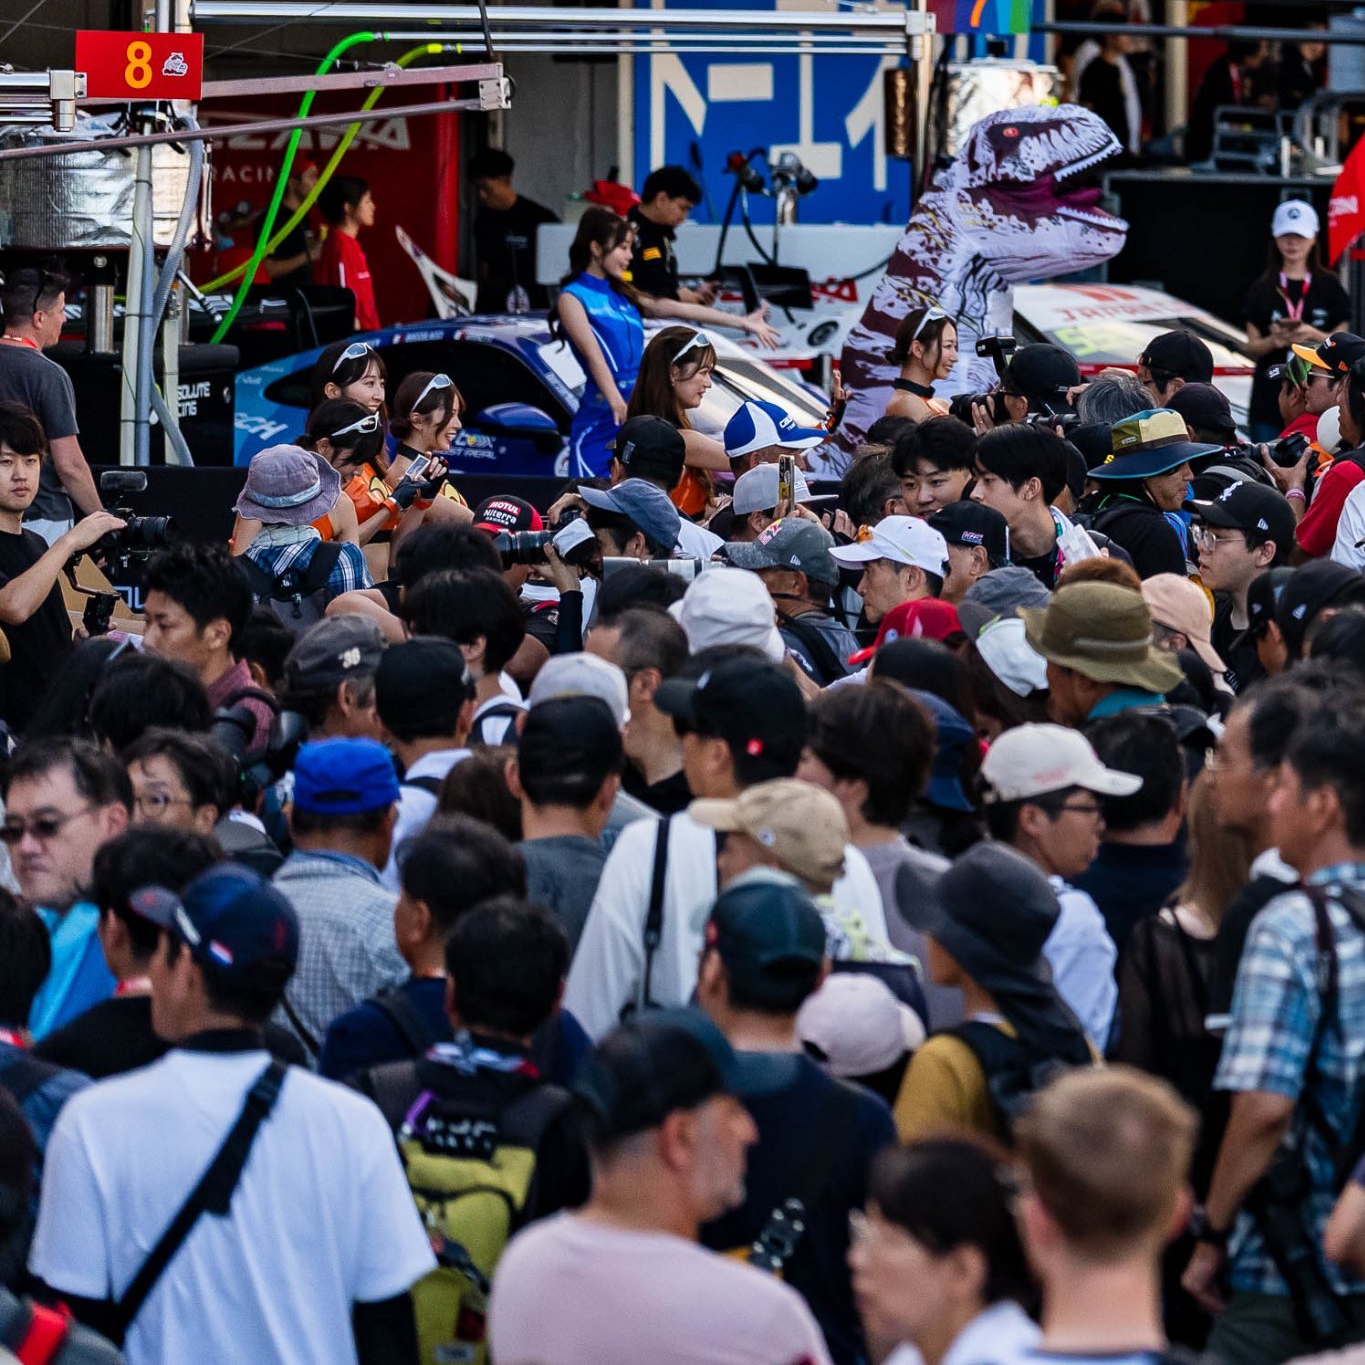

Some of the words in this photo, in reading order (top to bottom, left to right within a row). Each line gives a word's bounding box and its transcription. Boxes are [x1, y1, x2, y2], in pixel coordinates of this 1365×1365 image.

[124, 41, 153, 89] 8
[177, 381, 210, 402] SOLUTE
[483, 509, 517, 524] Niterra
[488, 501, 519, 515] MOTUL
